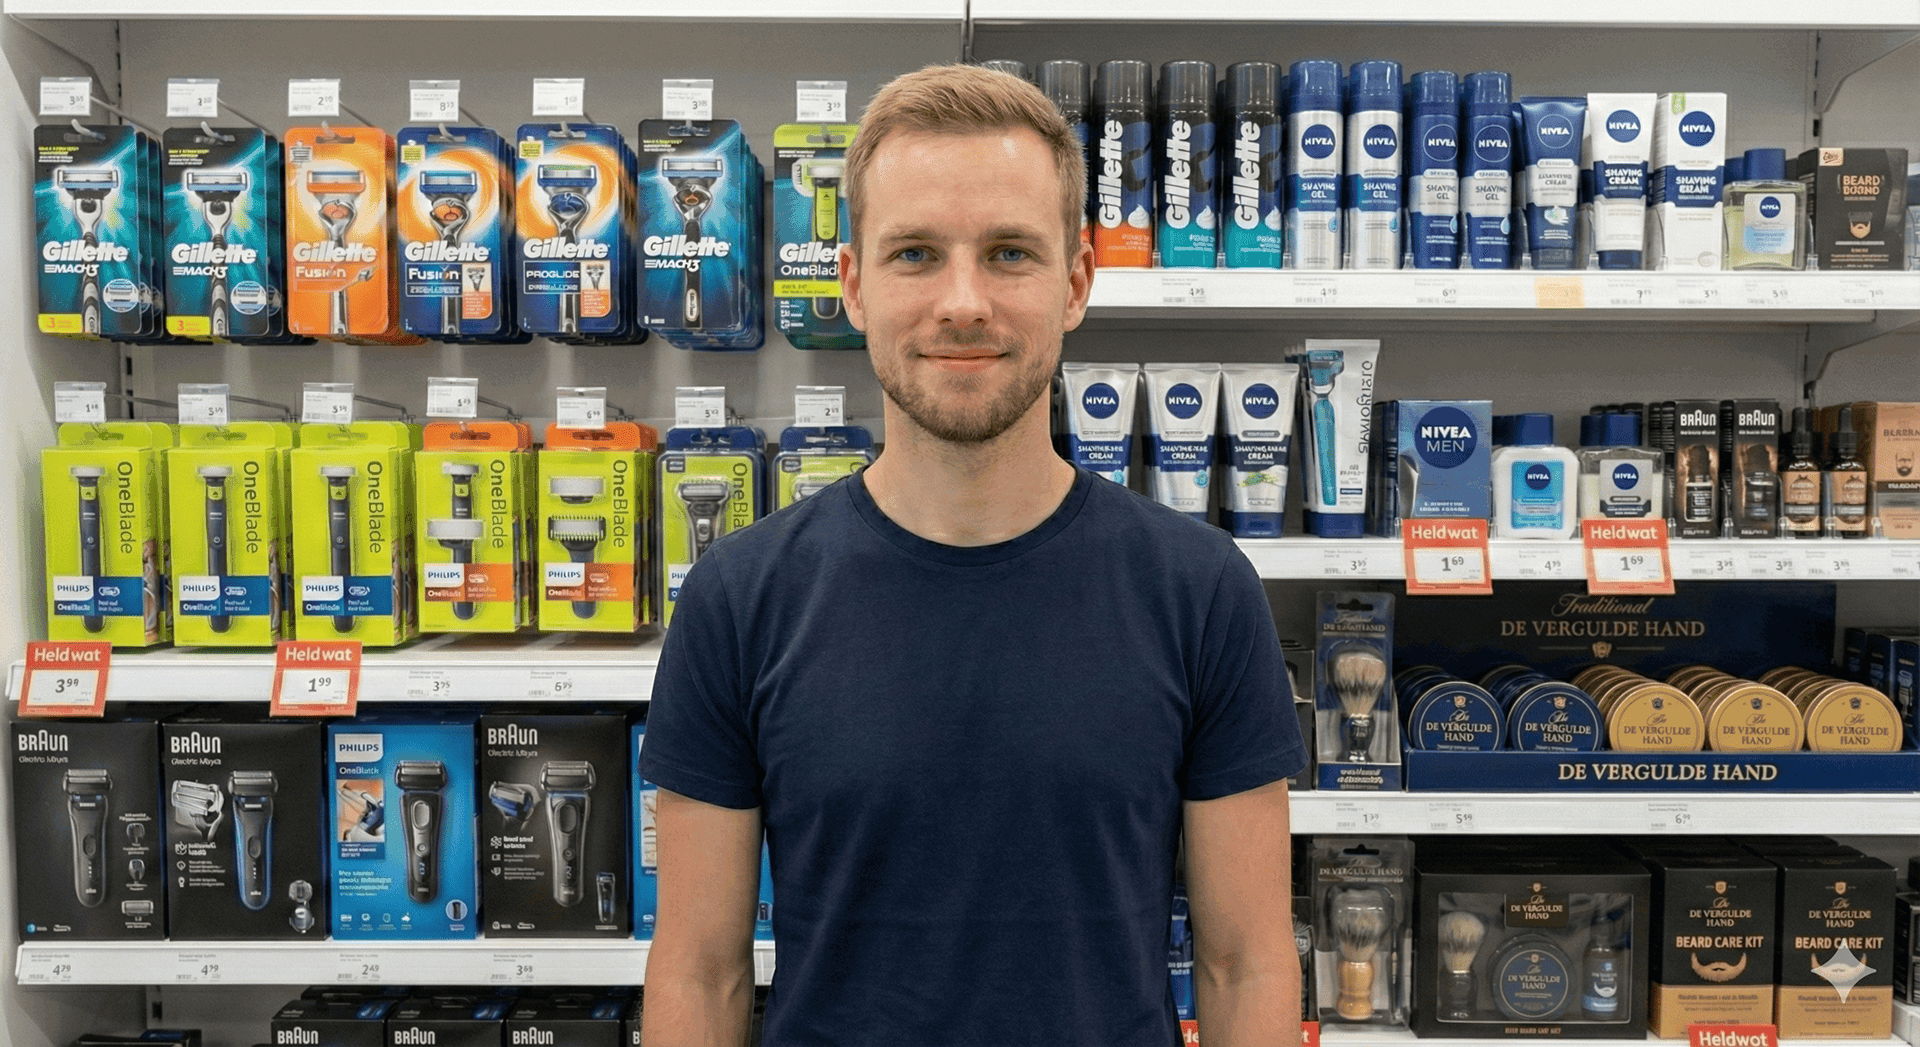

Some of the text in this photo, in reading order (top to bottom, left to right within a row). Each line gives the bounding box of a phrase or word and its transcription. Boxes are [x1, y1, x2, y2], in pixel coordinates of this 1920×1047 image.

[1540, 127, 1569, 135] NIVEA
[1609, 122, 1639, 131] NIVEA
[1682, 124, 1712, 133] NIVEA
[1305, 138, 1334, 146] NIVEA
[1366, 138, 1395, 147] NIVEA
[1428, 138, 1456, 147] NIVEA
[1478, 139, 1507, 148] NIVEA
[1098, 120, 1123, 229] Gillette
[1164, 120, 1192, 229] Gillette
[1233, 121, 1261, 230] Gillette
[1604, 168, 1643, 178] SHAVING
[1675, 176, 1717, 185] SHAVING
[1842, 175, 1881, 186] BEARD
[1301, 183, 1335, 191] SHAVING
[1363, 183, 1396, 191] SHAVING
[1426, 185, 1457, 194] SHAVING
[1475, 185, 1507, 194] SHAVING
[1311, 190, 1327, 199] GEL
[1373, 190, 1388, 199] GEL
[1436, 192, 1450, 200] GEL
[1485, 193, 1499, 201] GEL
[42, 239, 129, 262] Gillette
[523, 237, 610, 259] Gillette
[643, 234, 729, 257] Gillette
[171, 242, 257, 265] Gillette
[293, 241, 378, 262] Gillette
[405, 241, 490, 262] Gillette
[52, 264, 100, 278] MACH3
[655, 259, 701, 273] MACH3
[781, 264, 838, 276] OneBlad
[180, 265, 229, 280] MACH3
[526, 270, 580, 279] PROGLIDE
[47, 317, 56, 328] 3
[176, 320, 184, 331] 3
[1086, 396, 1116, 405] NIVEA
[1168, 396, 1199, 405] NIVEA
[1245, 396, 1275, 405] NIVEA
[1680, 409, 1716, 426] BRAUN
[1739, 409, 1775, 426] BRAUN
[1421, 426, 1472, 439] NIVEA
[1426, 440, 1465, 453] MEN
[1527, 473, 1549, 481] NIVEA
[1615, 472, 1637, 480] NIVEA
[732, 462, 750, 529] OneBla
[117, 461, 137, 554] OneBlade
[243, 461, 262, 554] OneBlade
[367, 461, 386, 554] OneBlade
[490, 459, 508, 549] OneBlade
[612, 459, 631, 549] OneBlade
[1411, 526, 1479, 539] Heldwat
[1591, 526, 1658, 539] Heldwat
[428, 571, 461, 580] PHILIPS
[548, 570, 581, 579] PHILIPS
[182, 584, 217, 593] PHILIPS
[305, 584, 340, 593] PHILIPS
[1551, 593, 1655, 617] Traditional
[1501, 621, 1705, 636] DE VERGULDE HAND
[1426, 722, 1439, 731] DE
[1525, 722, 1591, 734] DE VERGULDE
[1624, 726, 1691, 736] DE VERGULDE
[1723, 726, 1736, 735] DE
[1822, 726, 1835, 735] DE
[488, 723, 538, 745] BRAUN
[1444, 732, 1475, 742] HAND
[1543, 733, 1573, 743] HAND
[18, 729, 68, 751] BRAUN
[171, 731, 221, 753] BRAUN
[1642, 736, 1673, 745] HAND
[1741, 736, 1772, 745] HAND
[1840, 736, 1871, 745] HAND
[339, 743, 379, 752] PHILIPS
[1558, 764, 1777, 780] DE VERGULDE HAND
[1525, 912, 1549, 920] HAND
[1689, 909, 1752, 918] DE VERGULDE
[1809, 910, 1871, 919] DE VERGULDE
[1706, 919, 1735, 927] HAND
[1826, 920, 1855, 928] HAND
[1676, 936, 1764, 948] BEARD CARE KIT
[1795, 937, 1884, 949] BEARD CARE KIT
[277, 1026, 319, 1045] BRAUN
[394, 1026, 436, 1045] BRAUN
[512, 1026, 554, 1045] BRAUN
